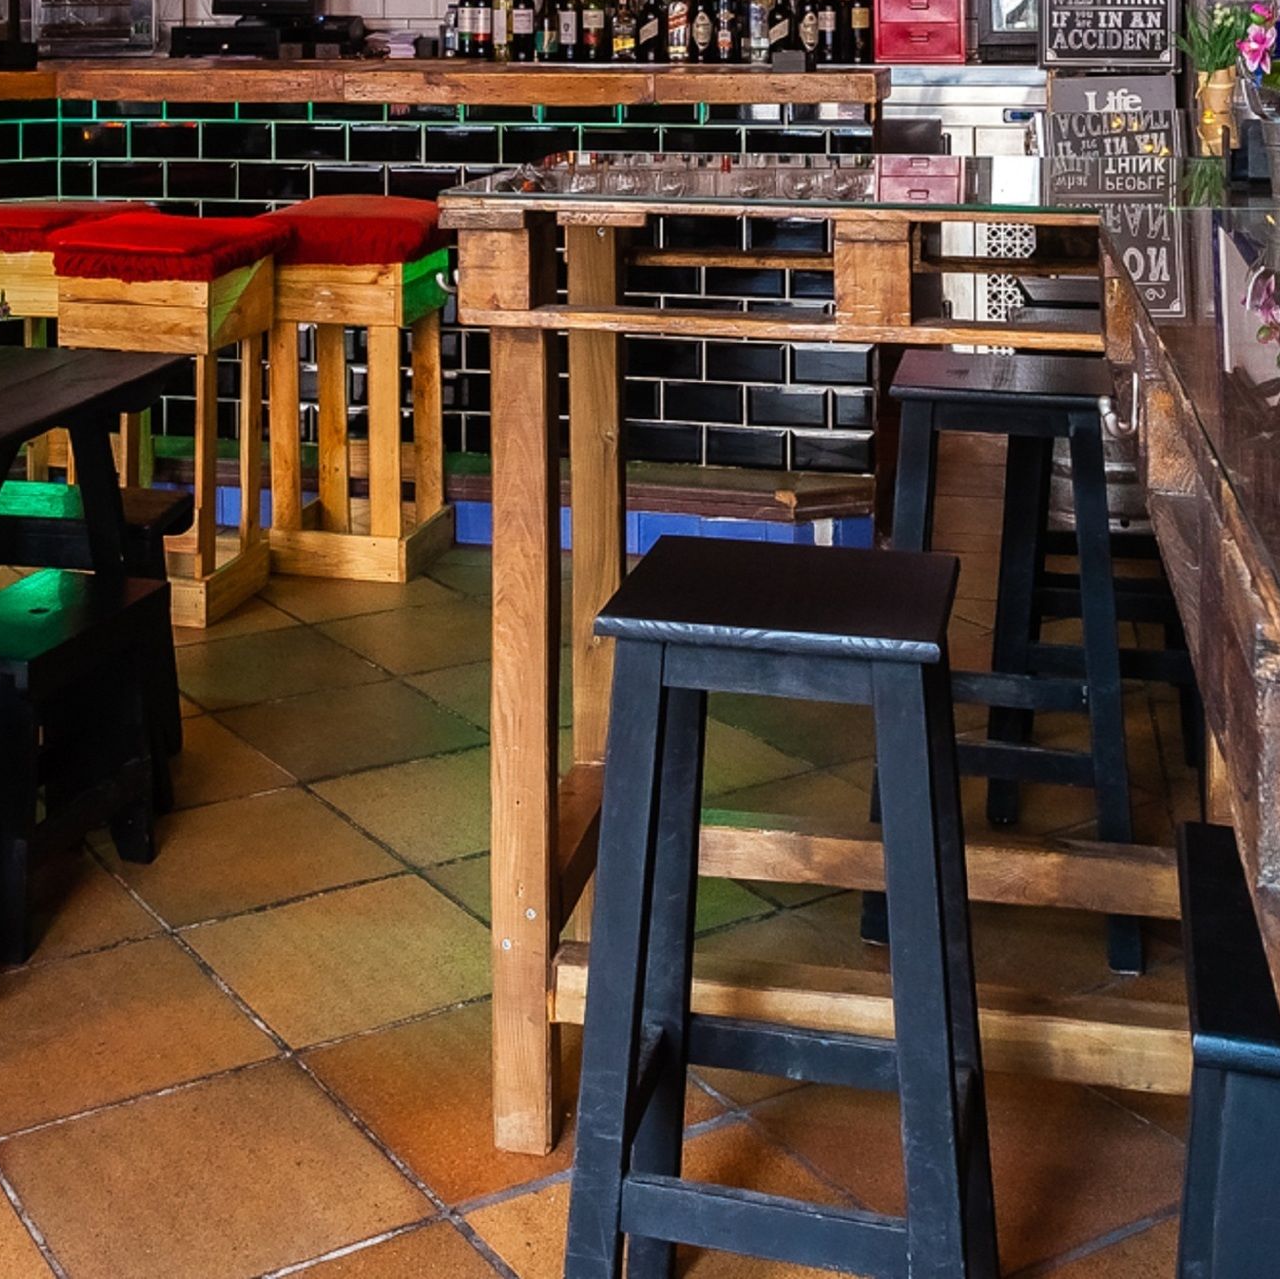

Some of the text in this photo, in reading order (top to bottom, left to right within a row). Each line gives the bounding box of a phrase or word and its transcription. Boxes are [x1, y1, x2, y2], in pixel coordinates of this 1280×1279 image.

[1052, 11, 1071, 28] IF
[1098, 11, 1124, 28] IN
[1129, 11, 1162, 28] AN
[1051, 29, 1165, 51] ACCIDENT
[1084, 88, 1142, 112] Life
